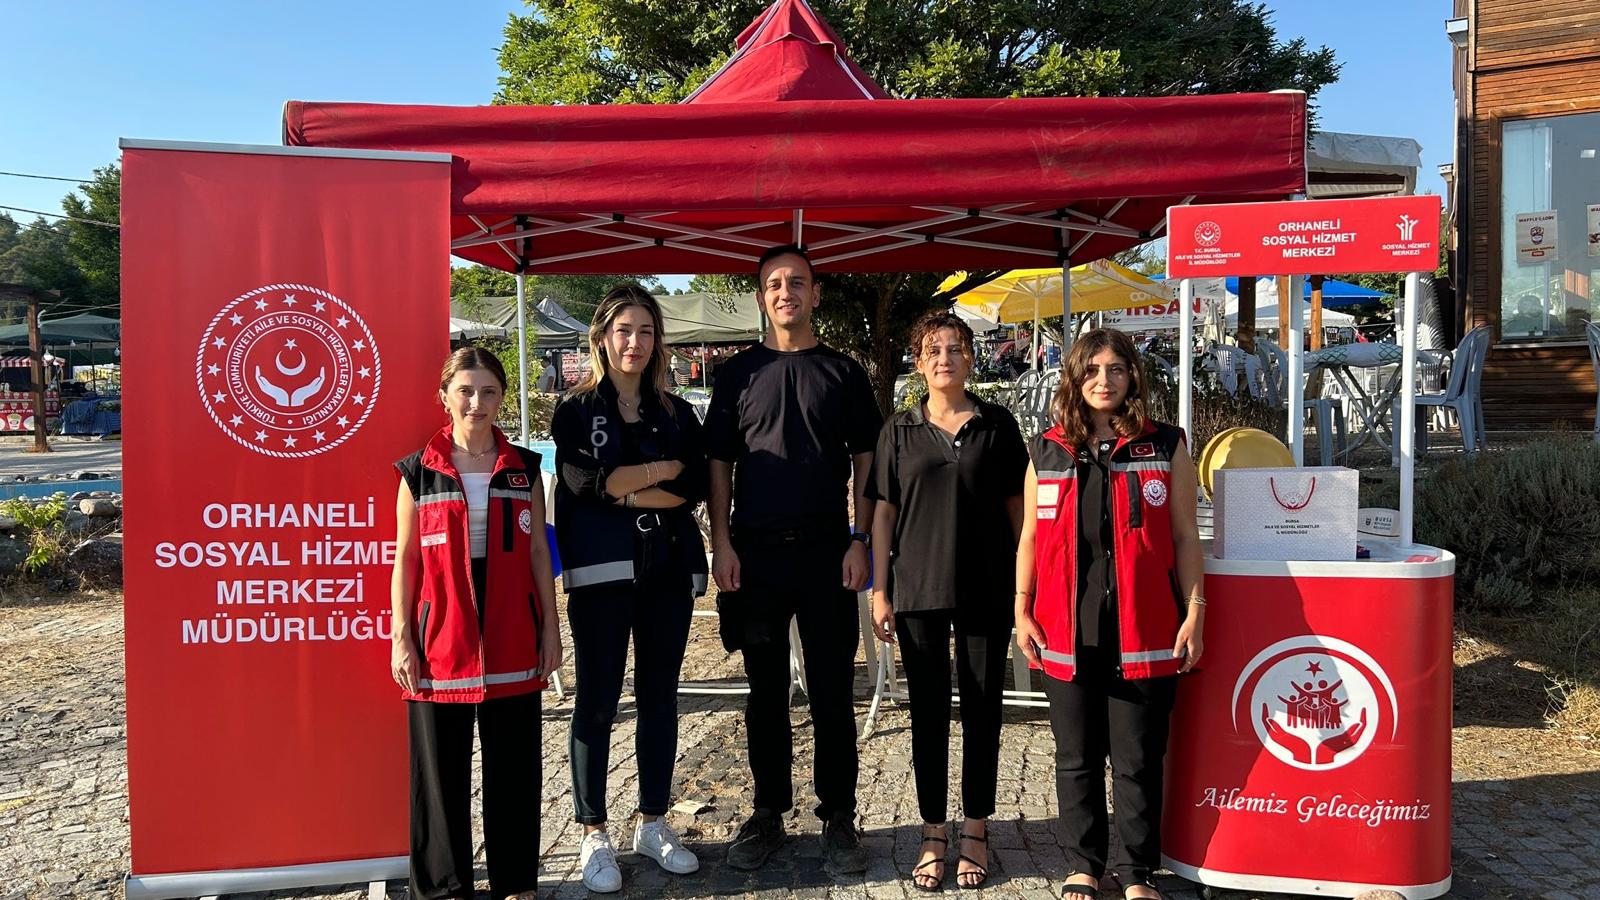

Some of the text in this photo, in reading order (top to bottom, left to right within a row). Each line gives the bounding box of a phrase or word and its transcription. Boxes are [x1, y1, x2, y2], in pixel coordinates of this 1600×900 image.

[1262, 232, 1357, 247] SOSYAL HİZMET
[1278, 218, 1341, 233] ORHANELİ
[1282, 245, 1336, 258] MERKEZİ
[230, 315, 349, 425] TÜRKİYE CUMHURİYETİ AİLE VE SOSYAL HİZMETLER BAKANLIĞI
[202, 496, 375, 528] ORHANELİ
[154, 534, 397, 568] SOSYAL HİZME
[216, 572, 364, 605] MERKEZİ
[182, 609, 394, 644] MÜDÜRLÜĞÜ
[1195, 787, 1431, 827] Ailemiz Geleceğimiz
